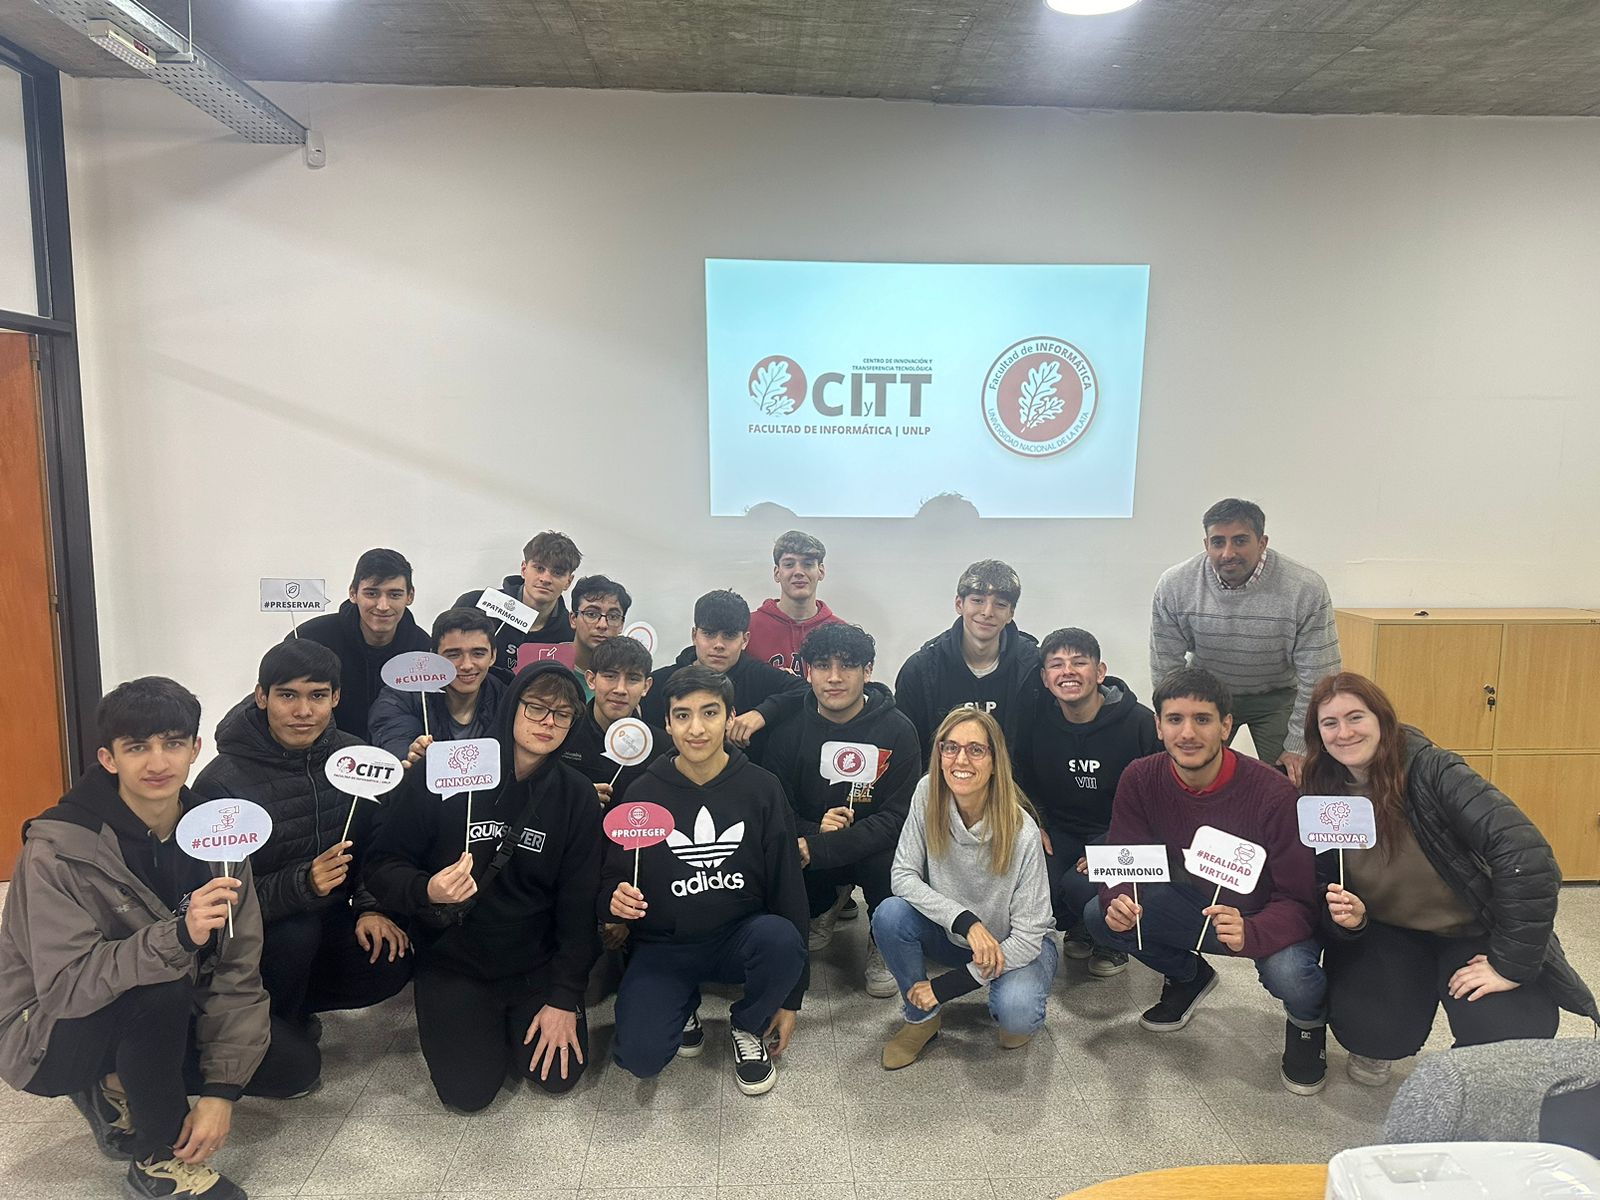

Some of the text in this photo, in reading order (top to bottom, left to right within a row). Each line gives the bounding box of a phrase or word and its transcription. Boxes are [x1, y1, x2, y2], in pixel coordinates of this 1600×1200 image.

[895, 364, 933, 372] TECNOLÓGICA
[989, 342, 1092, 390] Facultad de INFORMÁTICA
[748, 423, 931, 436] FACULTAD DE INFORMÁTICA UNLP
[988, 407, 1090, 453] UNIVERSIDAD NACIONAL DE LA PLATA
[263, 601, 321, 609] #PRESERVAR
[482, 601, 528, 628] #PATRIMONIO
[395, 673, 447, 685] #CUIDAR
[435, 774, 493, 788] #INNOVAR
[611, 828, 666, 838] #PROTEGER
[1308, 832, 1369, 844] #INNOVAR
[191, 832, 258, 849] #CUIDAR
[1196, 849, 1252, 877] #REALIDAD
[1093, 867, 1164, 876] #PATRIMONIO
[1199, 863, 1240, 887] VIRTUAL
